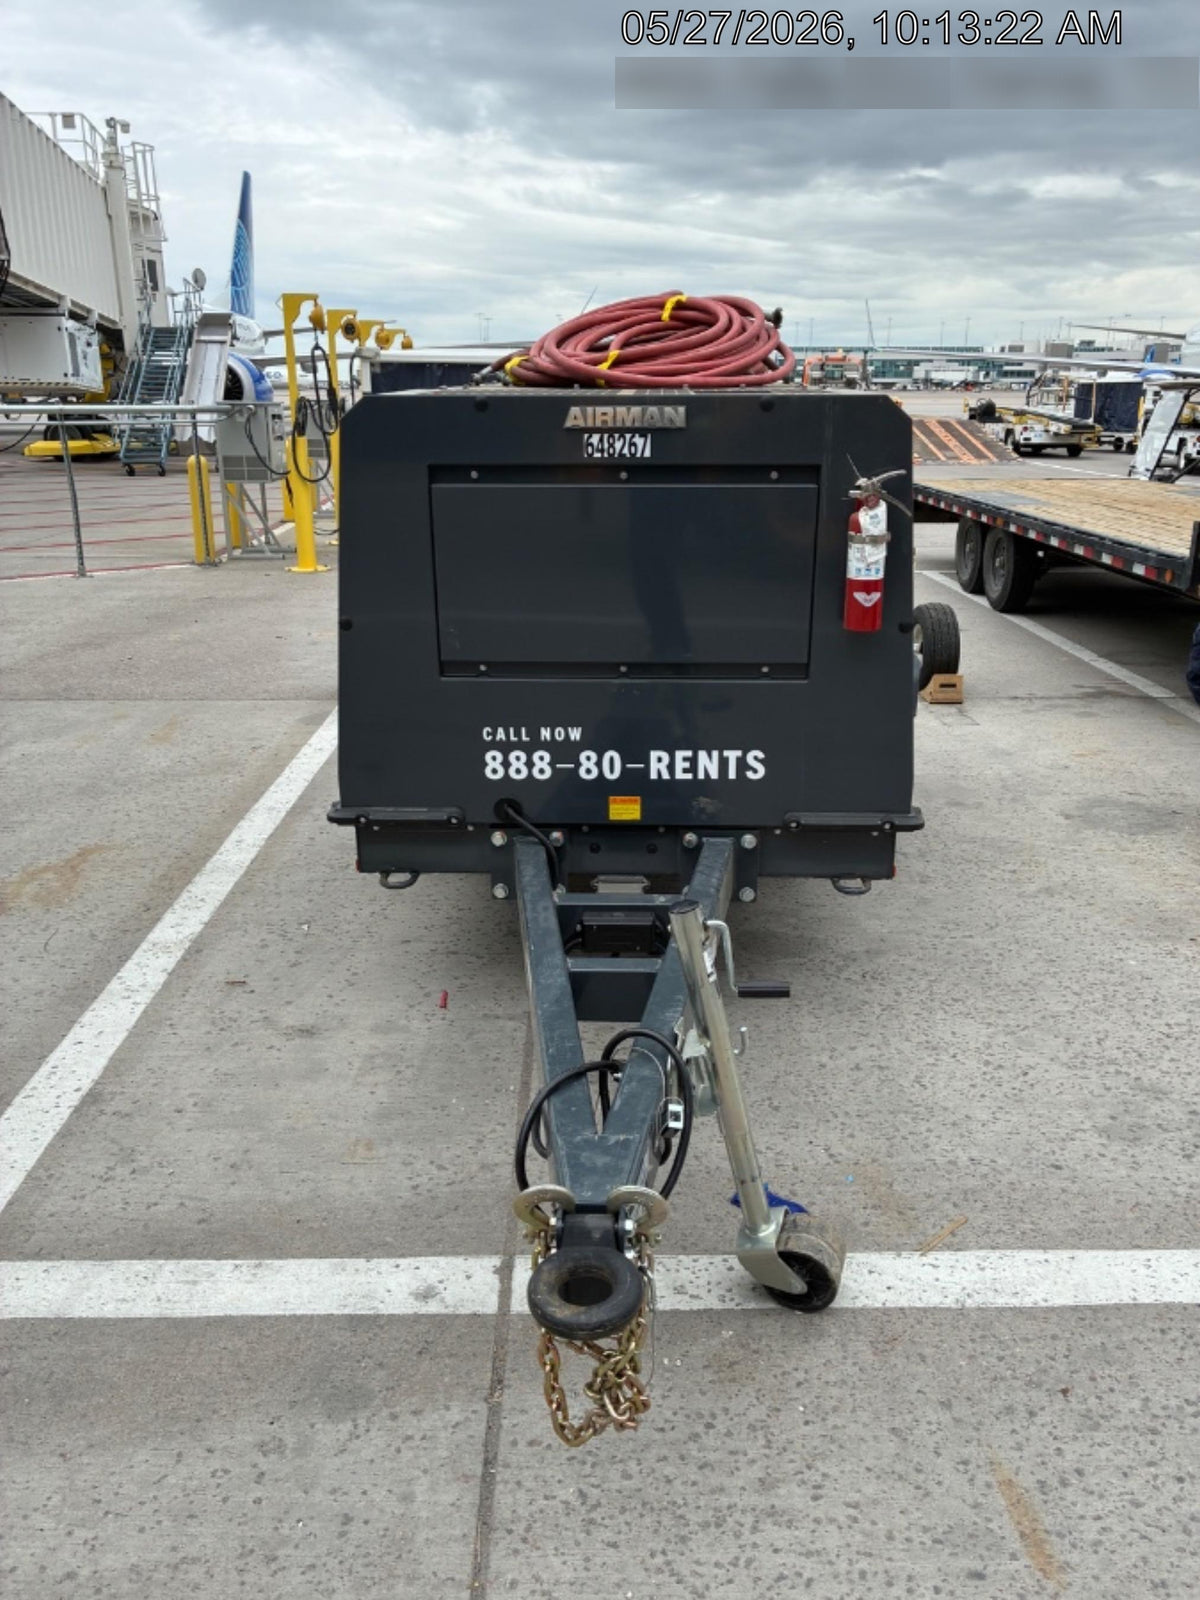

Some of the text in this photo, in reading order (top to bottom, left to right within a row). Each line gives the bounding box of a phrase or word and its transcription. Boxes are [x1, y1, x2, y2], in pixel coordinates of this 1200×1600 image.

[564, 405, 687, 428] AIRMAN
[585, 434, 649, 458] 648267
[482, 726, 582, 742] CALL NOW
[484, 749, 766, 781] 888-80-RENTS
